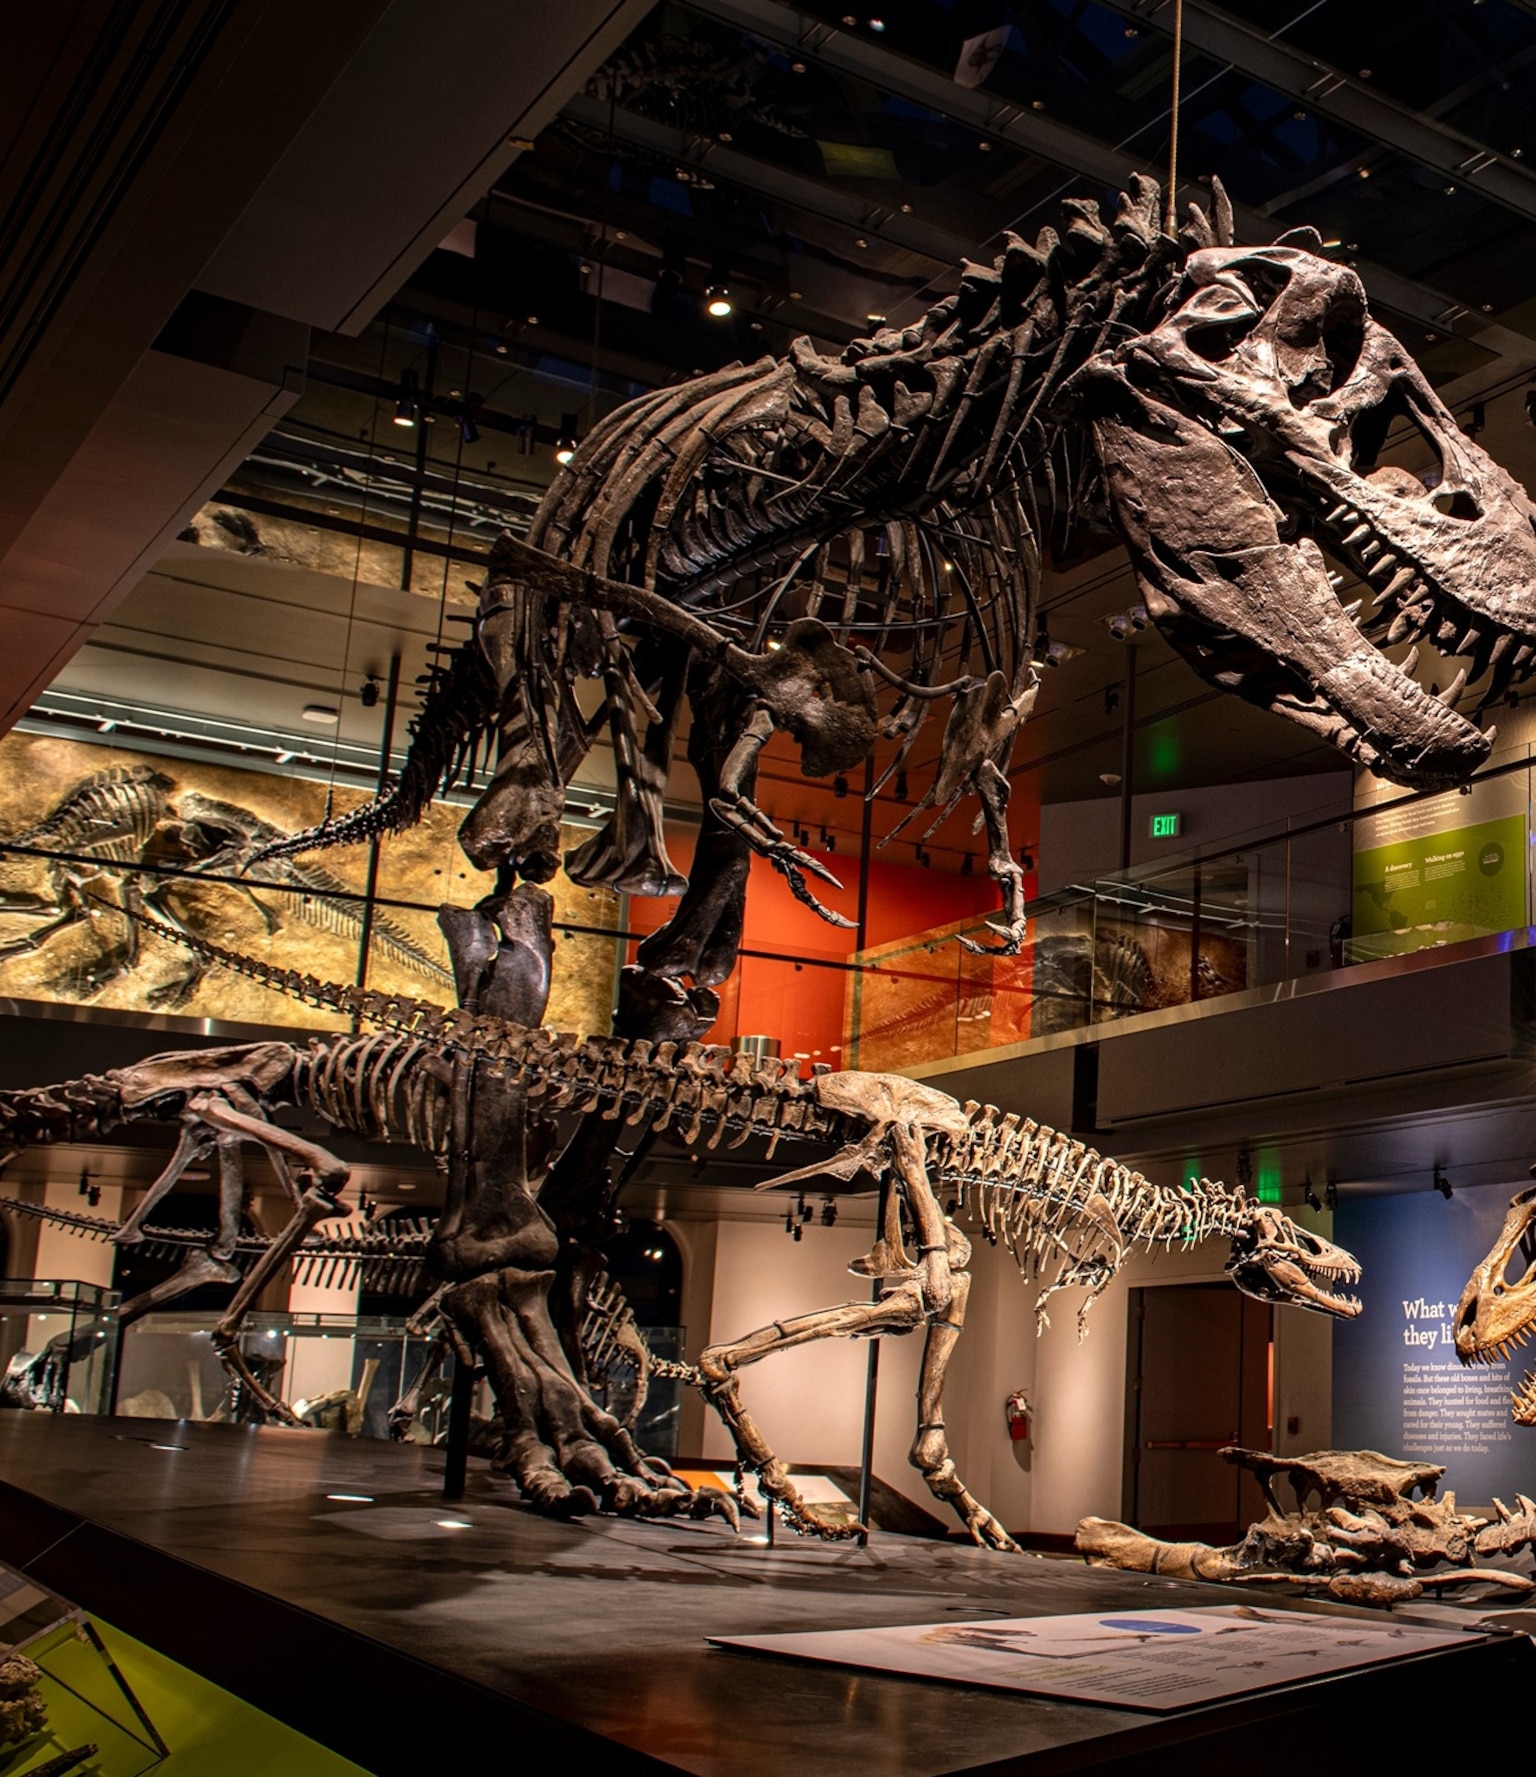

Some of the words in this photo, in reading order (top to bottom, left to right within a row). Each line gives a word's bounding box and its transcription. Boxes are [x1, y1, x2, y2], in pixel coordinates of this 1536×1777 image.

[1153, 815, 1177, 836] EXIT
[1402, 1297, 1445, 1320] What
[1403, 1324, 1438, 1350] they
[1450, 1373, 1460, 1382] old
[1460, 1372, 1479, 1382] bones
[1479, 1372, 1491, 1382] and
[1430, 1384, 1457, 1396] belonged
[1475, 1395, 1489, 1405] food
